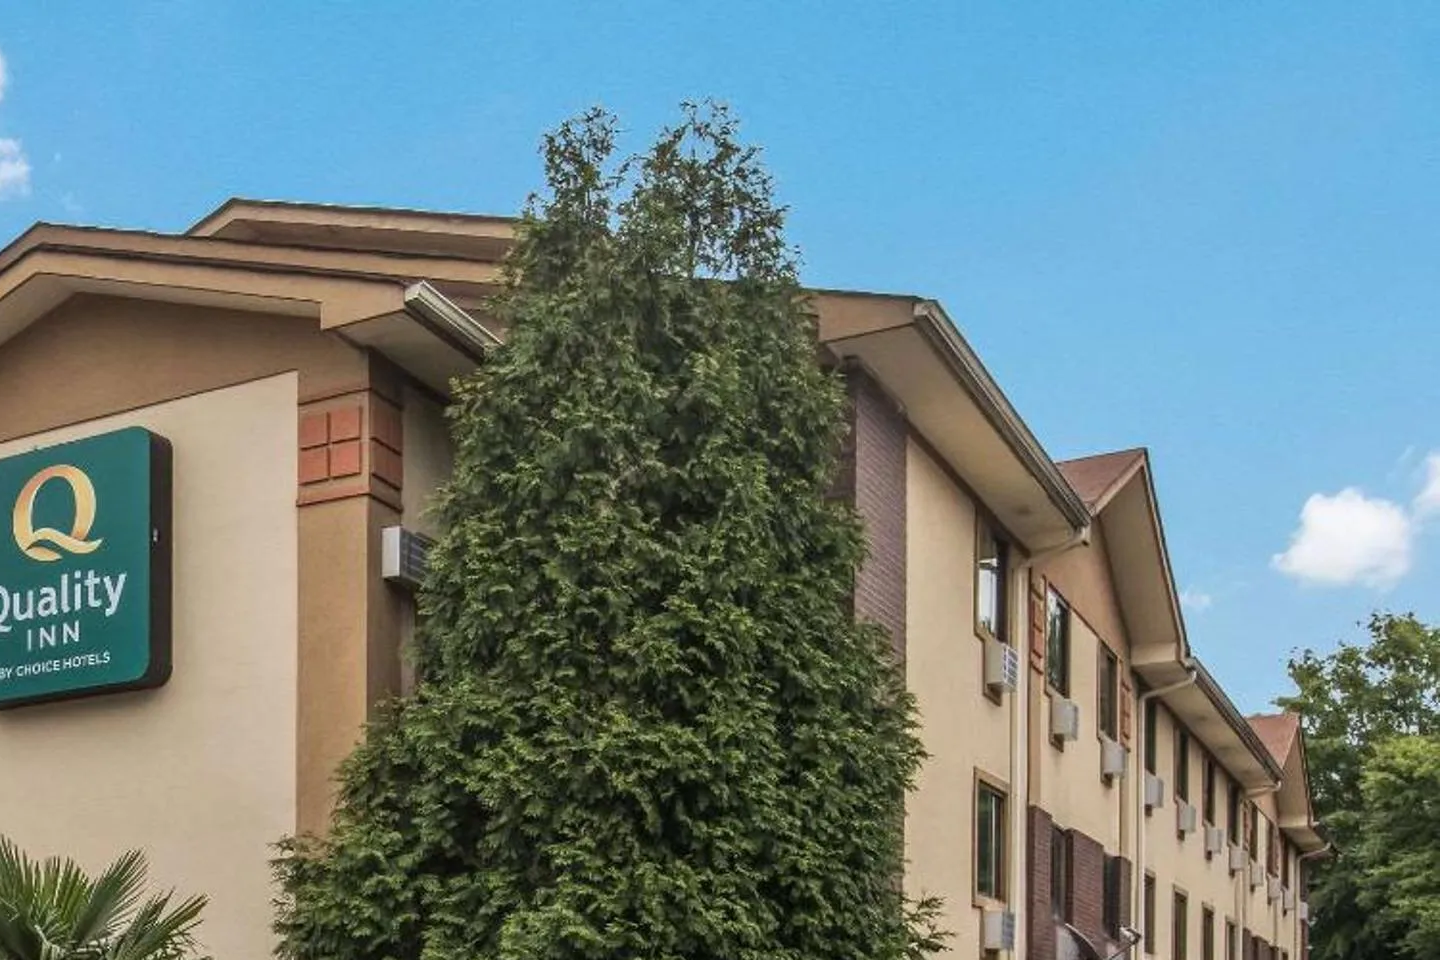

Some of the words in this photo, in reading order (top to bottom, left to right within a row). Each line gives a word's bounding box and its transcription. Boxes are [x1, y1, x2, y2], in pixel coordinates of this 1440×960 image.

[13, 464, 104, 562] Q
[26, 620, 81, 651] INN
[16, 660, 61, 677] CHOICE
[62, 651, 111, 670] HOTELS
